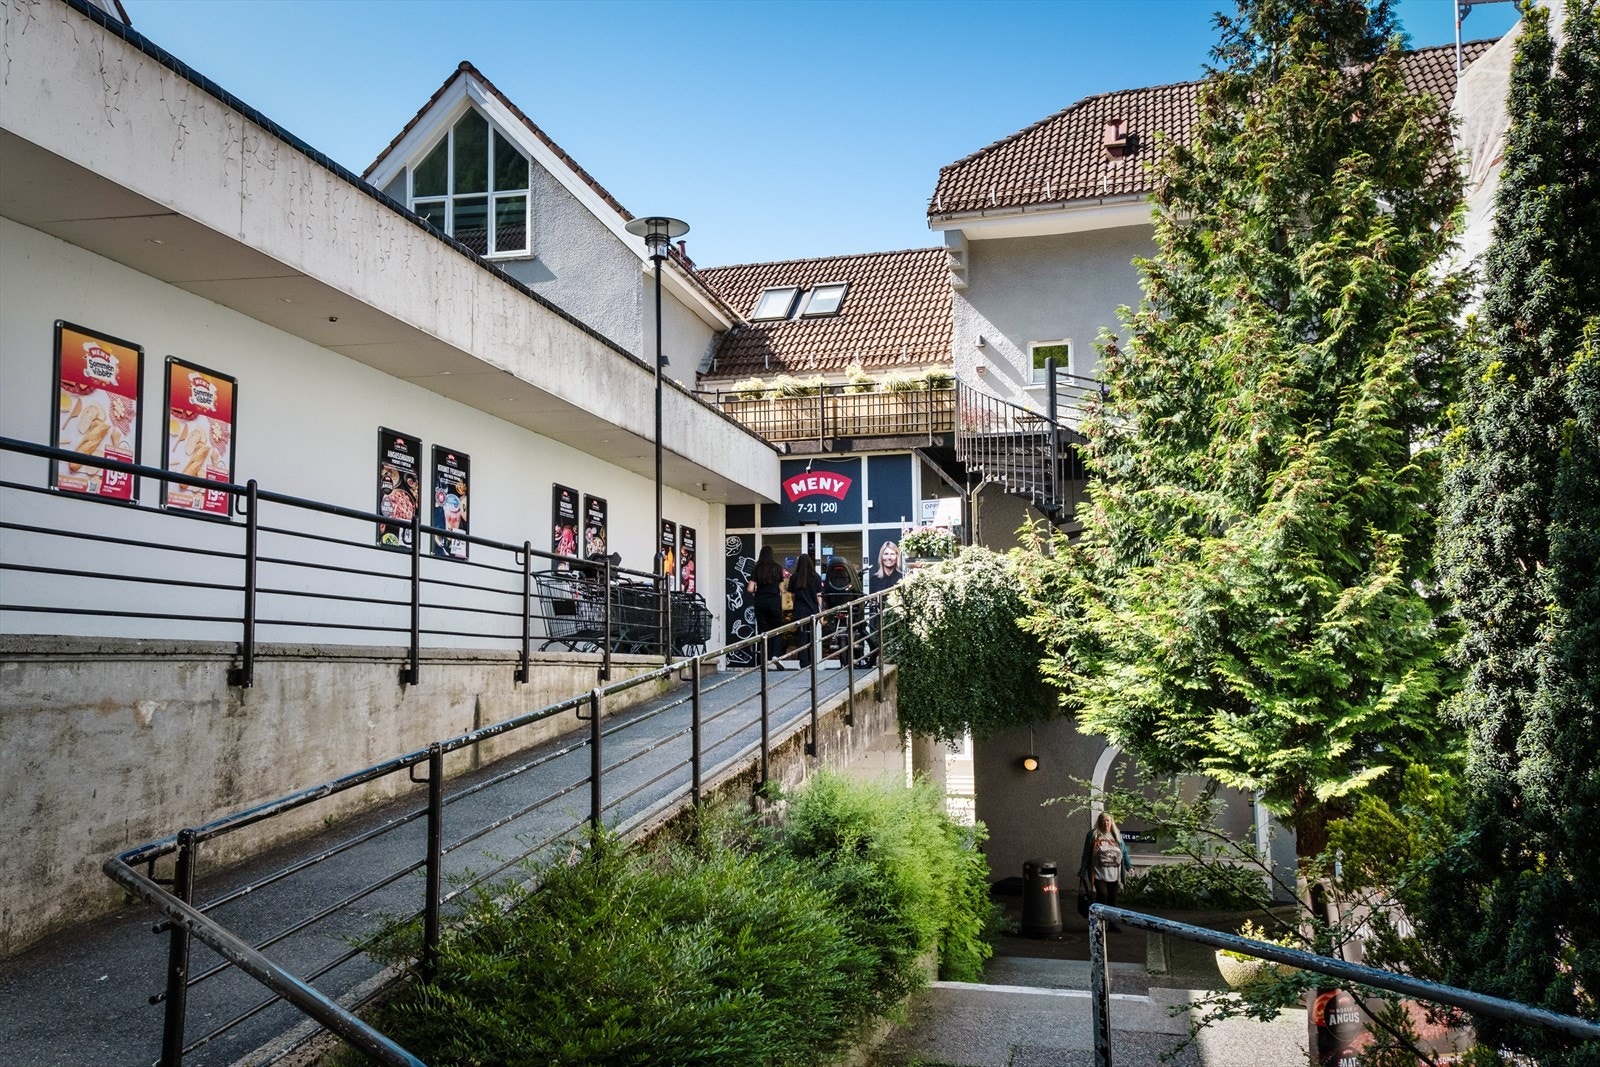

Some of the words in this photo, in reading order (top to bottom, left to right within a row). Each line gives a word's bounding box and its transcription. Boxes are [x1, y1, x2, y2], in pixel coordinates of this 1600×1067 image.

[791, 477, 844, 495] MENY
[798, 503, 817, 513] 7-21
[820, 502, 838, 514] (20)
[1329, 1012, 1360, 1026] ANGUS
